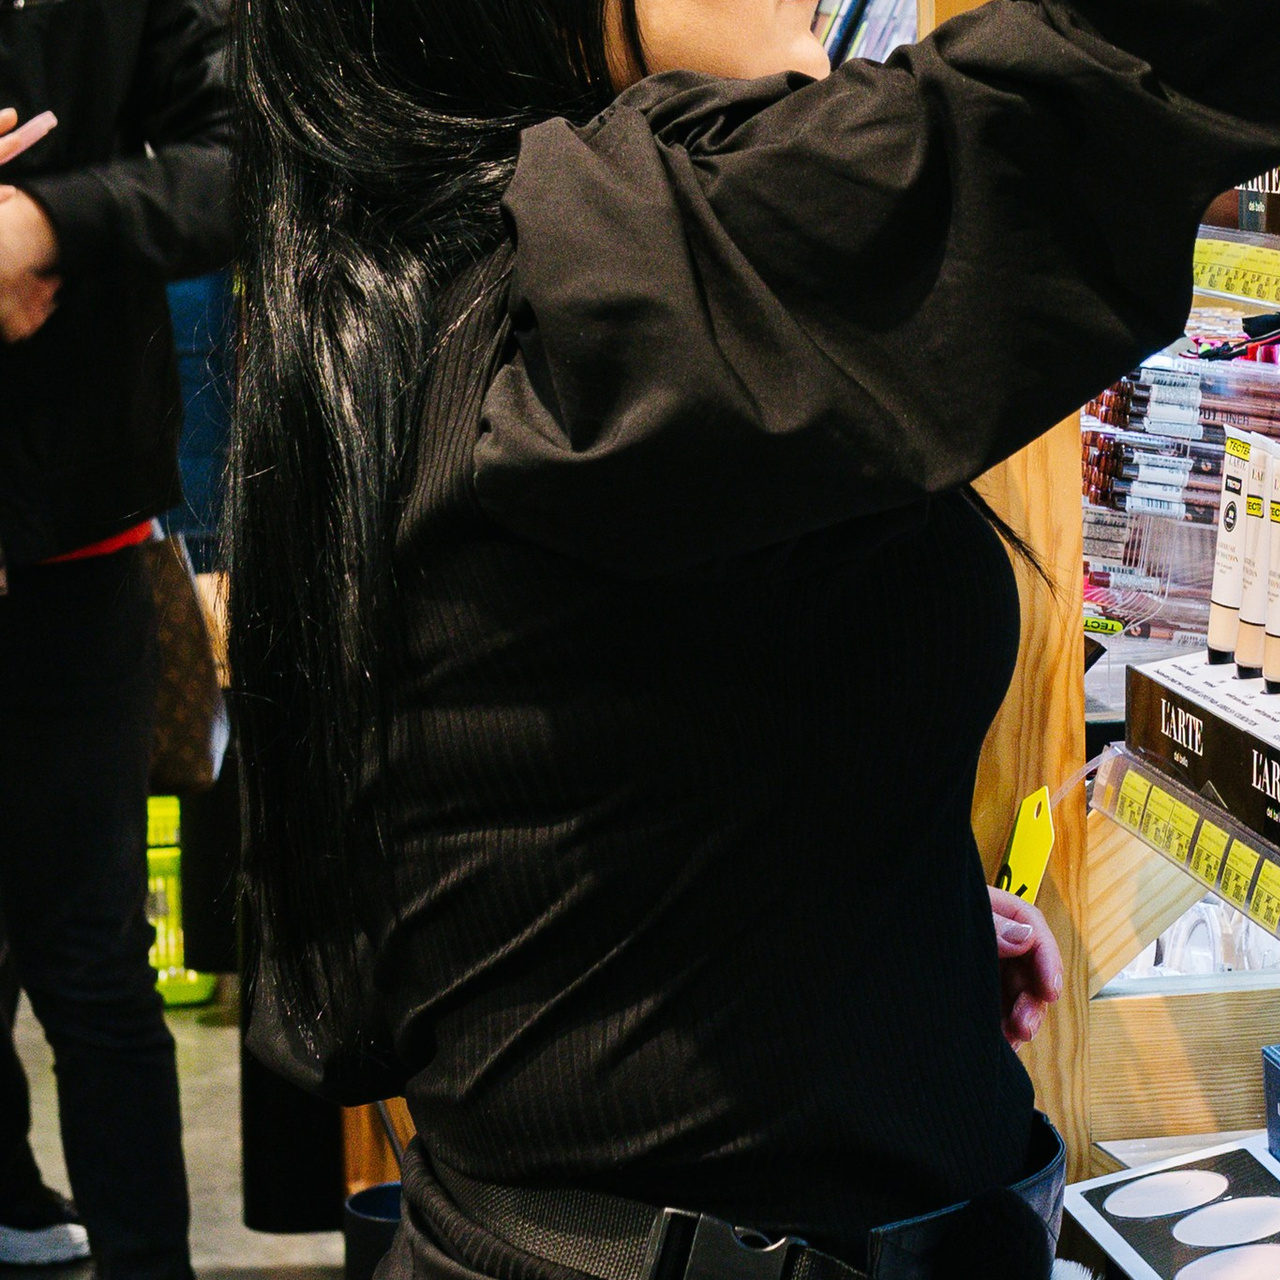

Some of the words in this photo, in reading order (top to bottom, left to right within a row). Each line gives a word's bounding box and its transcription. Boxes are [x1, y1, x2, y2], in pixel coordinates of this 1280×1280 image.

[1234, 166, 1280, 195] ARTE
[1083, 621, 1117, 631] ТЕСТ
[1160, 697, 1204, 757] L'ARTE
